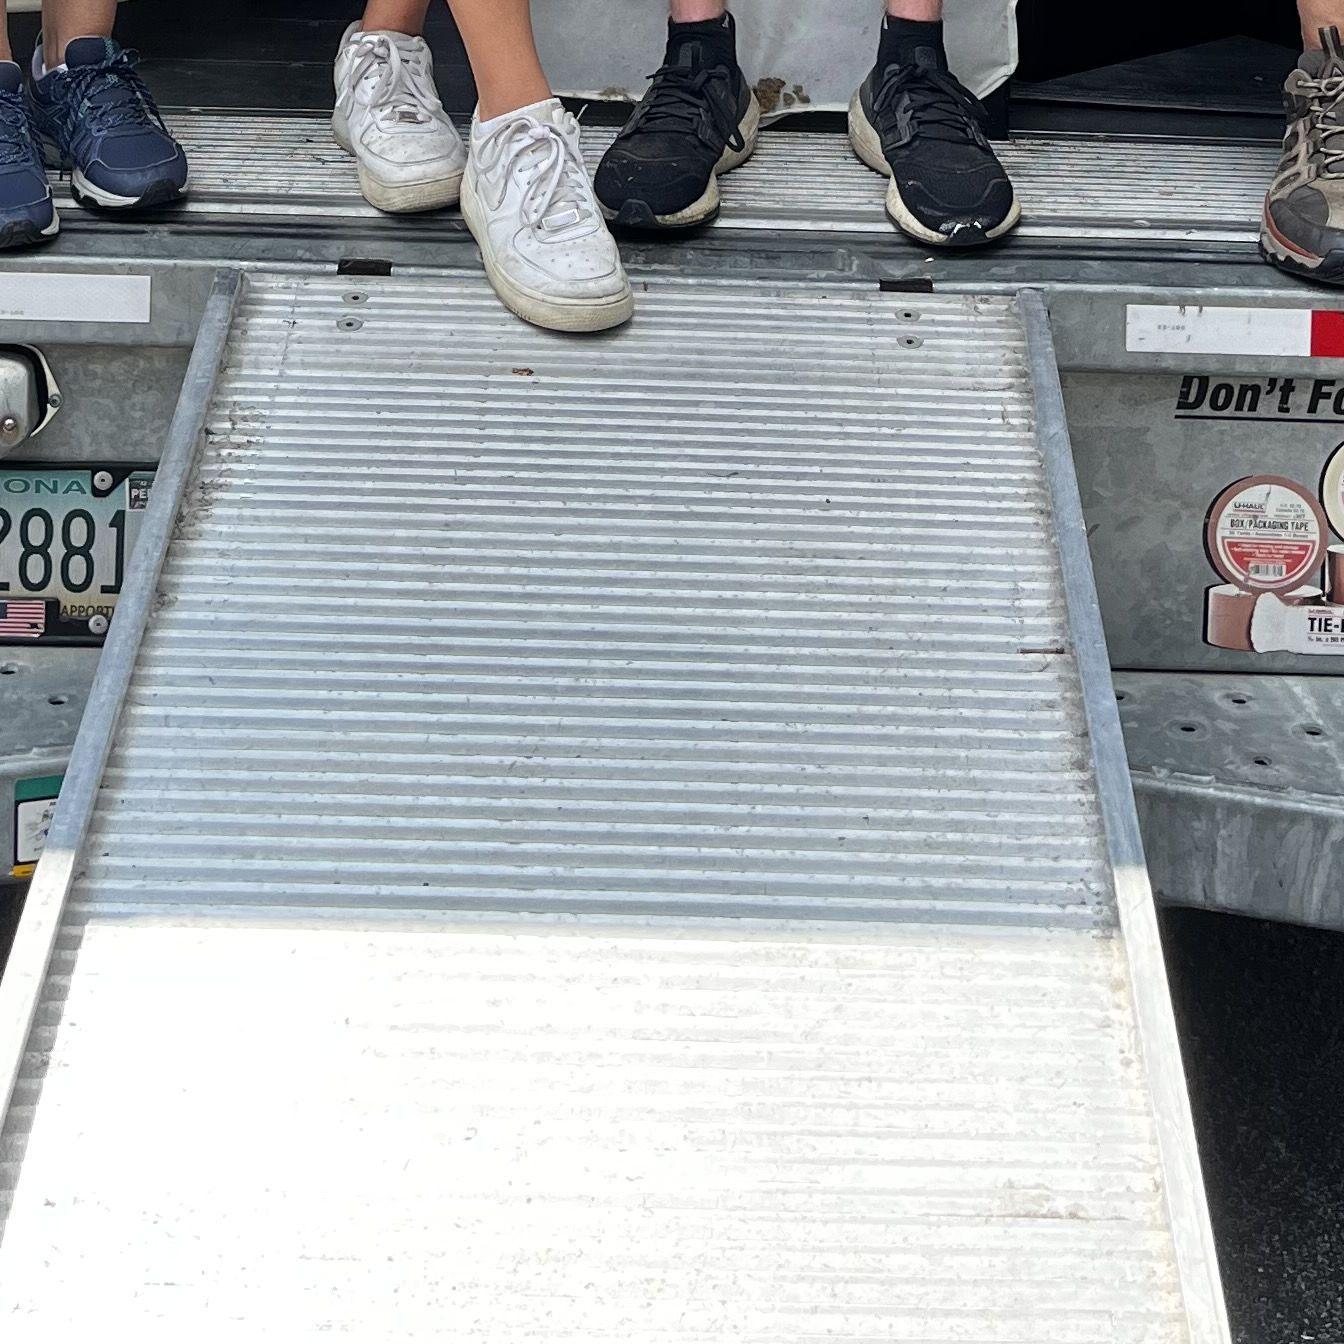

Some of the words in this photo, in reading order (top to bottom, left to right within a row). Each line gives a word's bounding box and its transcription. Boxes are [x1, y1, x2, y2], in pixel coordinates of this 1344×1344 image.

[1176, 374, 1296, 414] Don't
[1230, 518, 1289, 531] BOX/PACKAGING
[1290, 520, 1309, 532] TAPE
